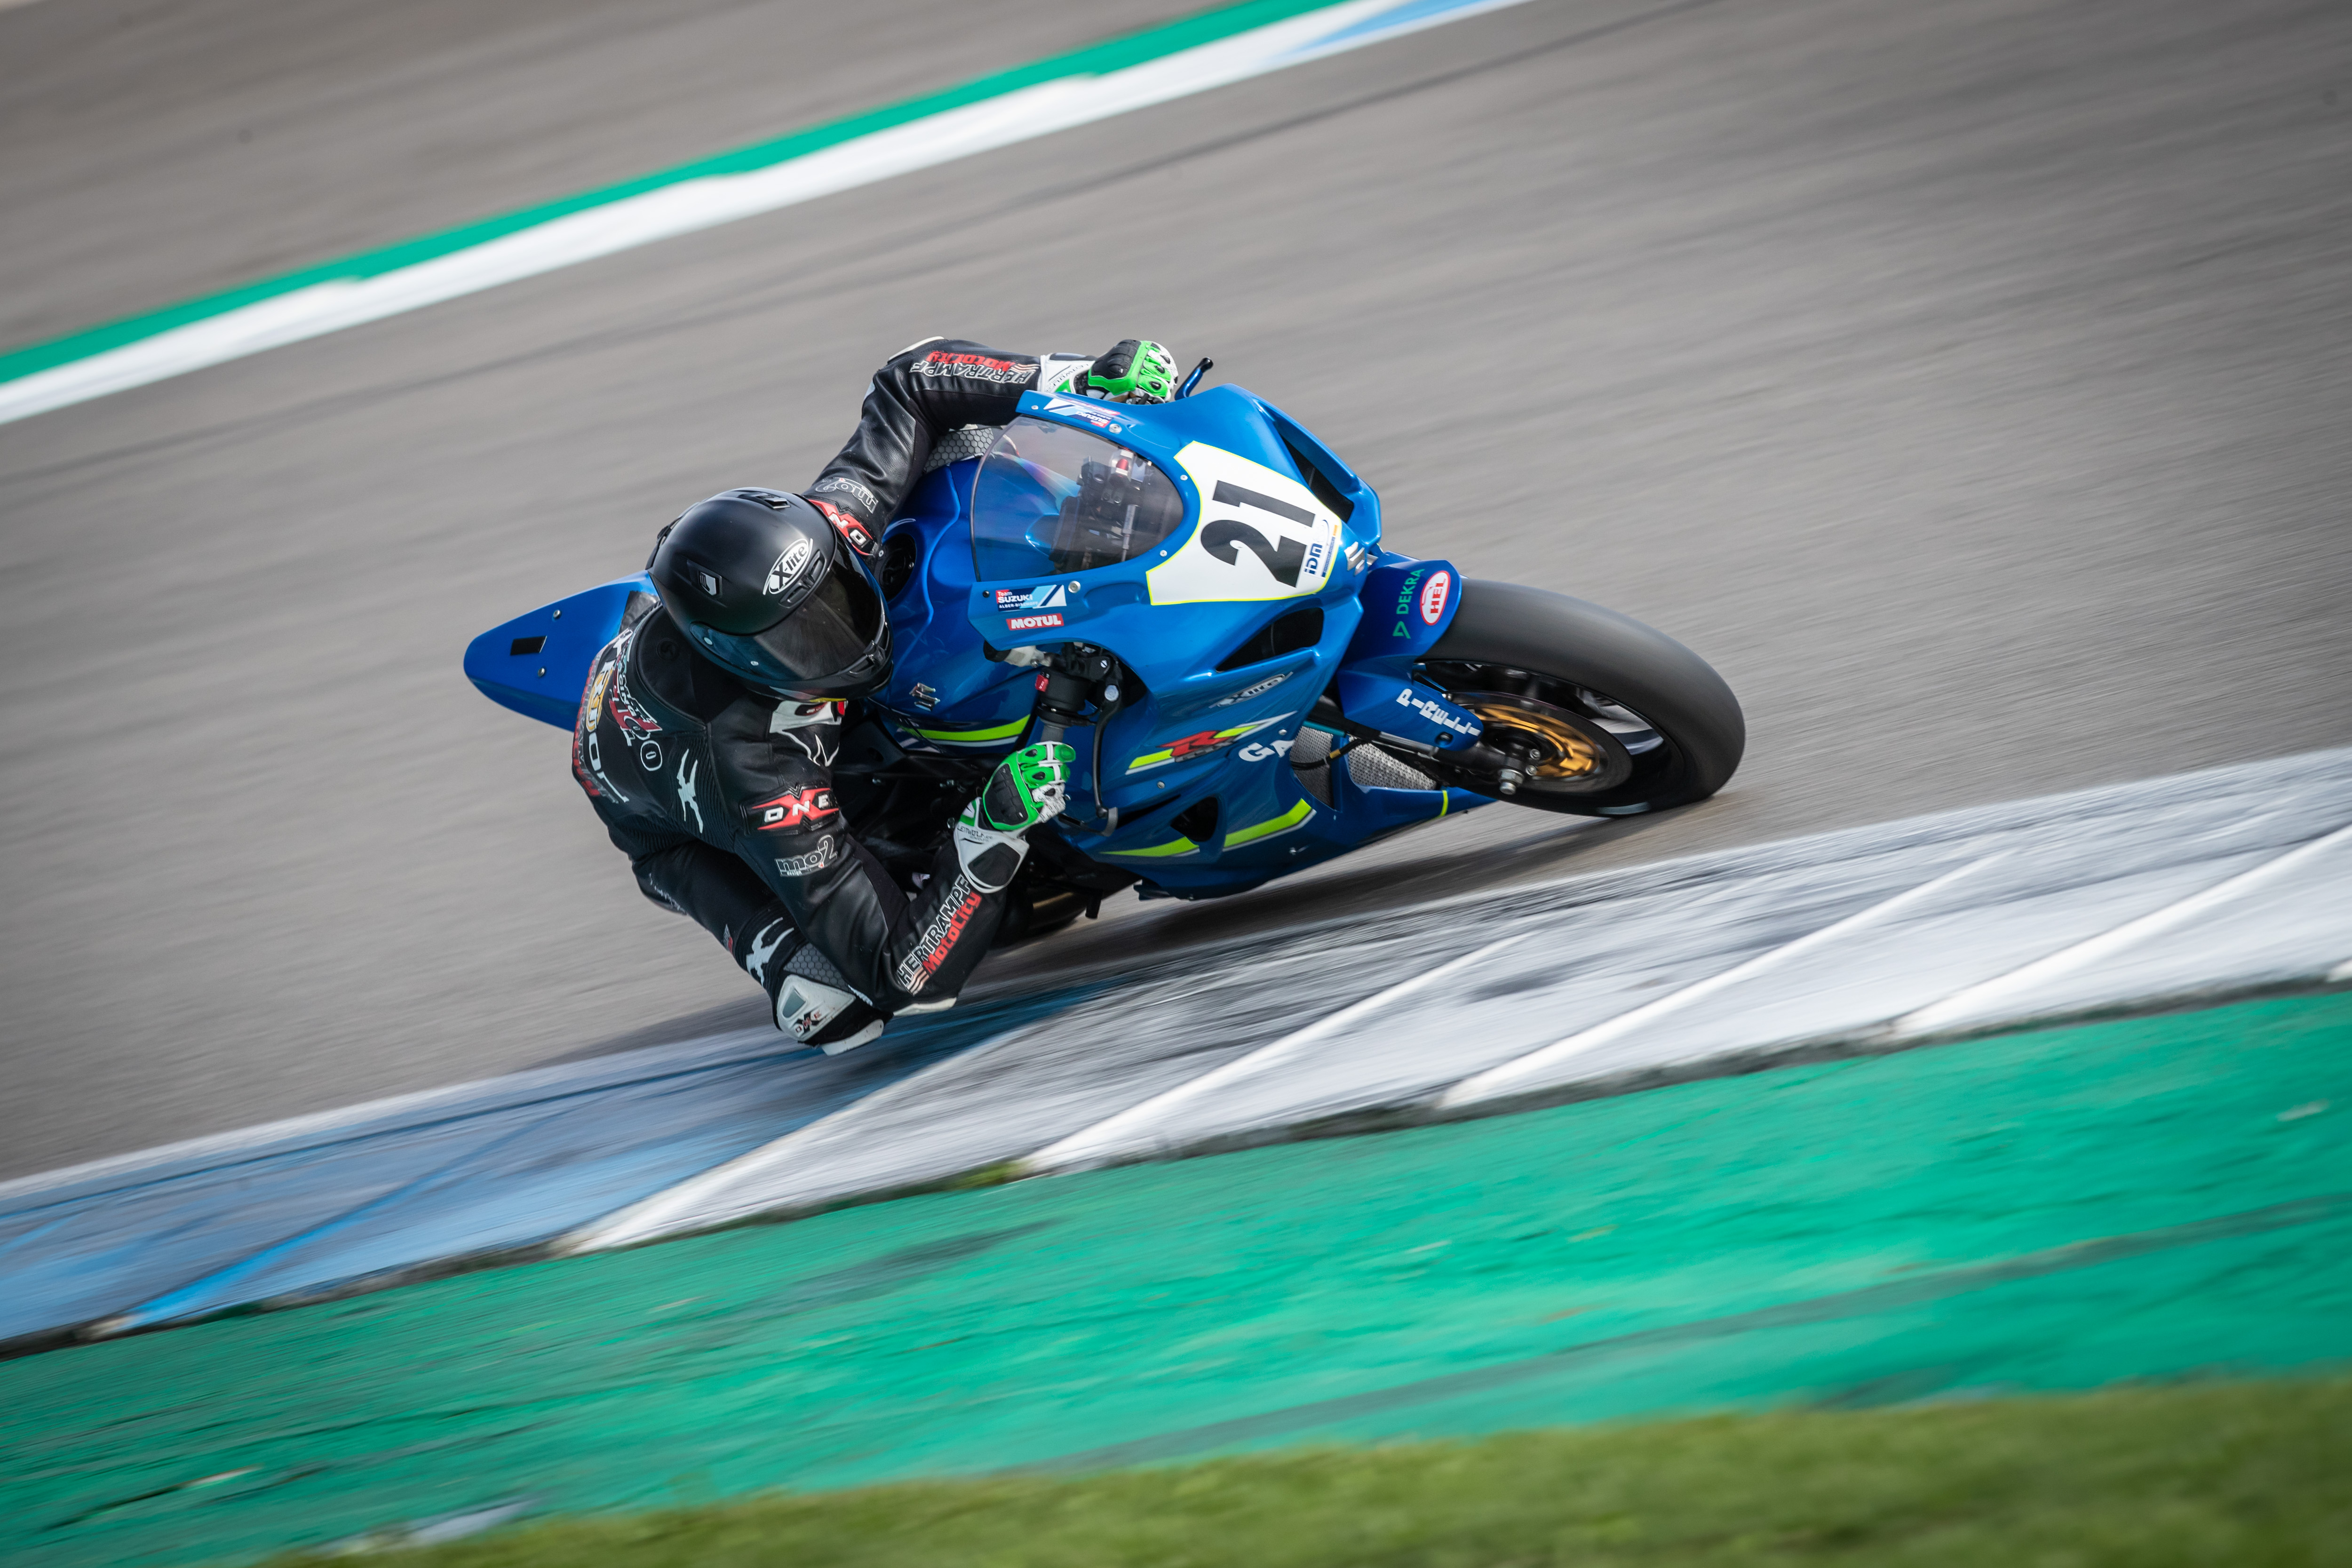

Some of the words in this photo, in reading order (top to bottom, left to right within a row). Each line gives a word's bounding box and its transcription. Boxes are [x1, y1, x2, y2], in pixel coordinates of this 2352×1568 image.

[909, 361, 1035, 383] HERTRAMPF
[829, 513, 866, 544] ON
[1200, 480, 1316, 588] 21
[998, 594, 1033, 603] SUZUKI
[1397, 569, 1424, 614] DEKRA
[1430, 579, 1446, 613] HEL
[1011, 615, 1061, 629] MOTUL
[1396, 688, 1481, 736] PIRELLI
[764, 794, 828, 823] ONE
[895, 874, 971, 987] HERTRAMPF
[922, 891, 982, 976] MotoCity
